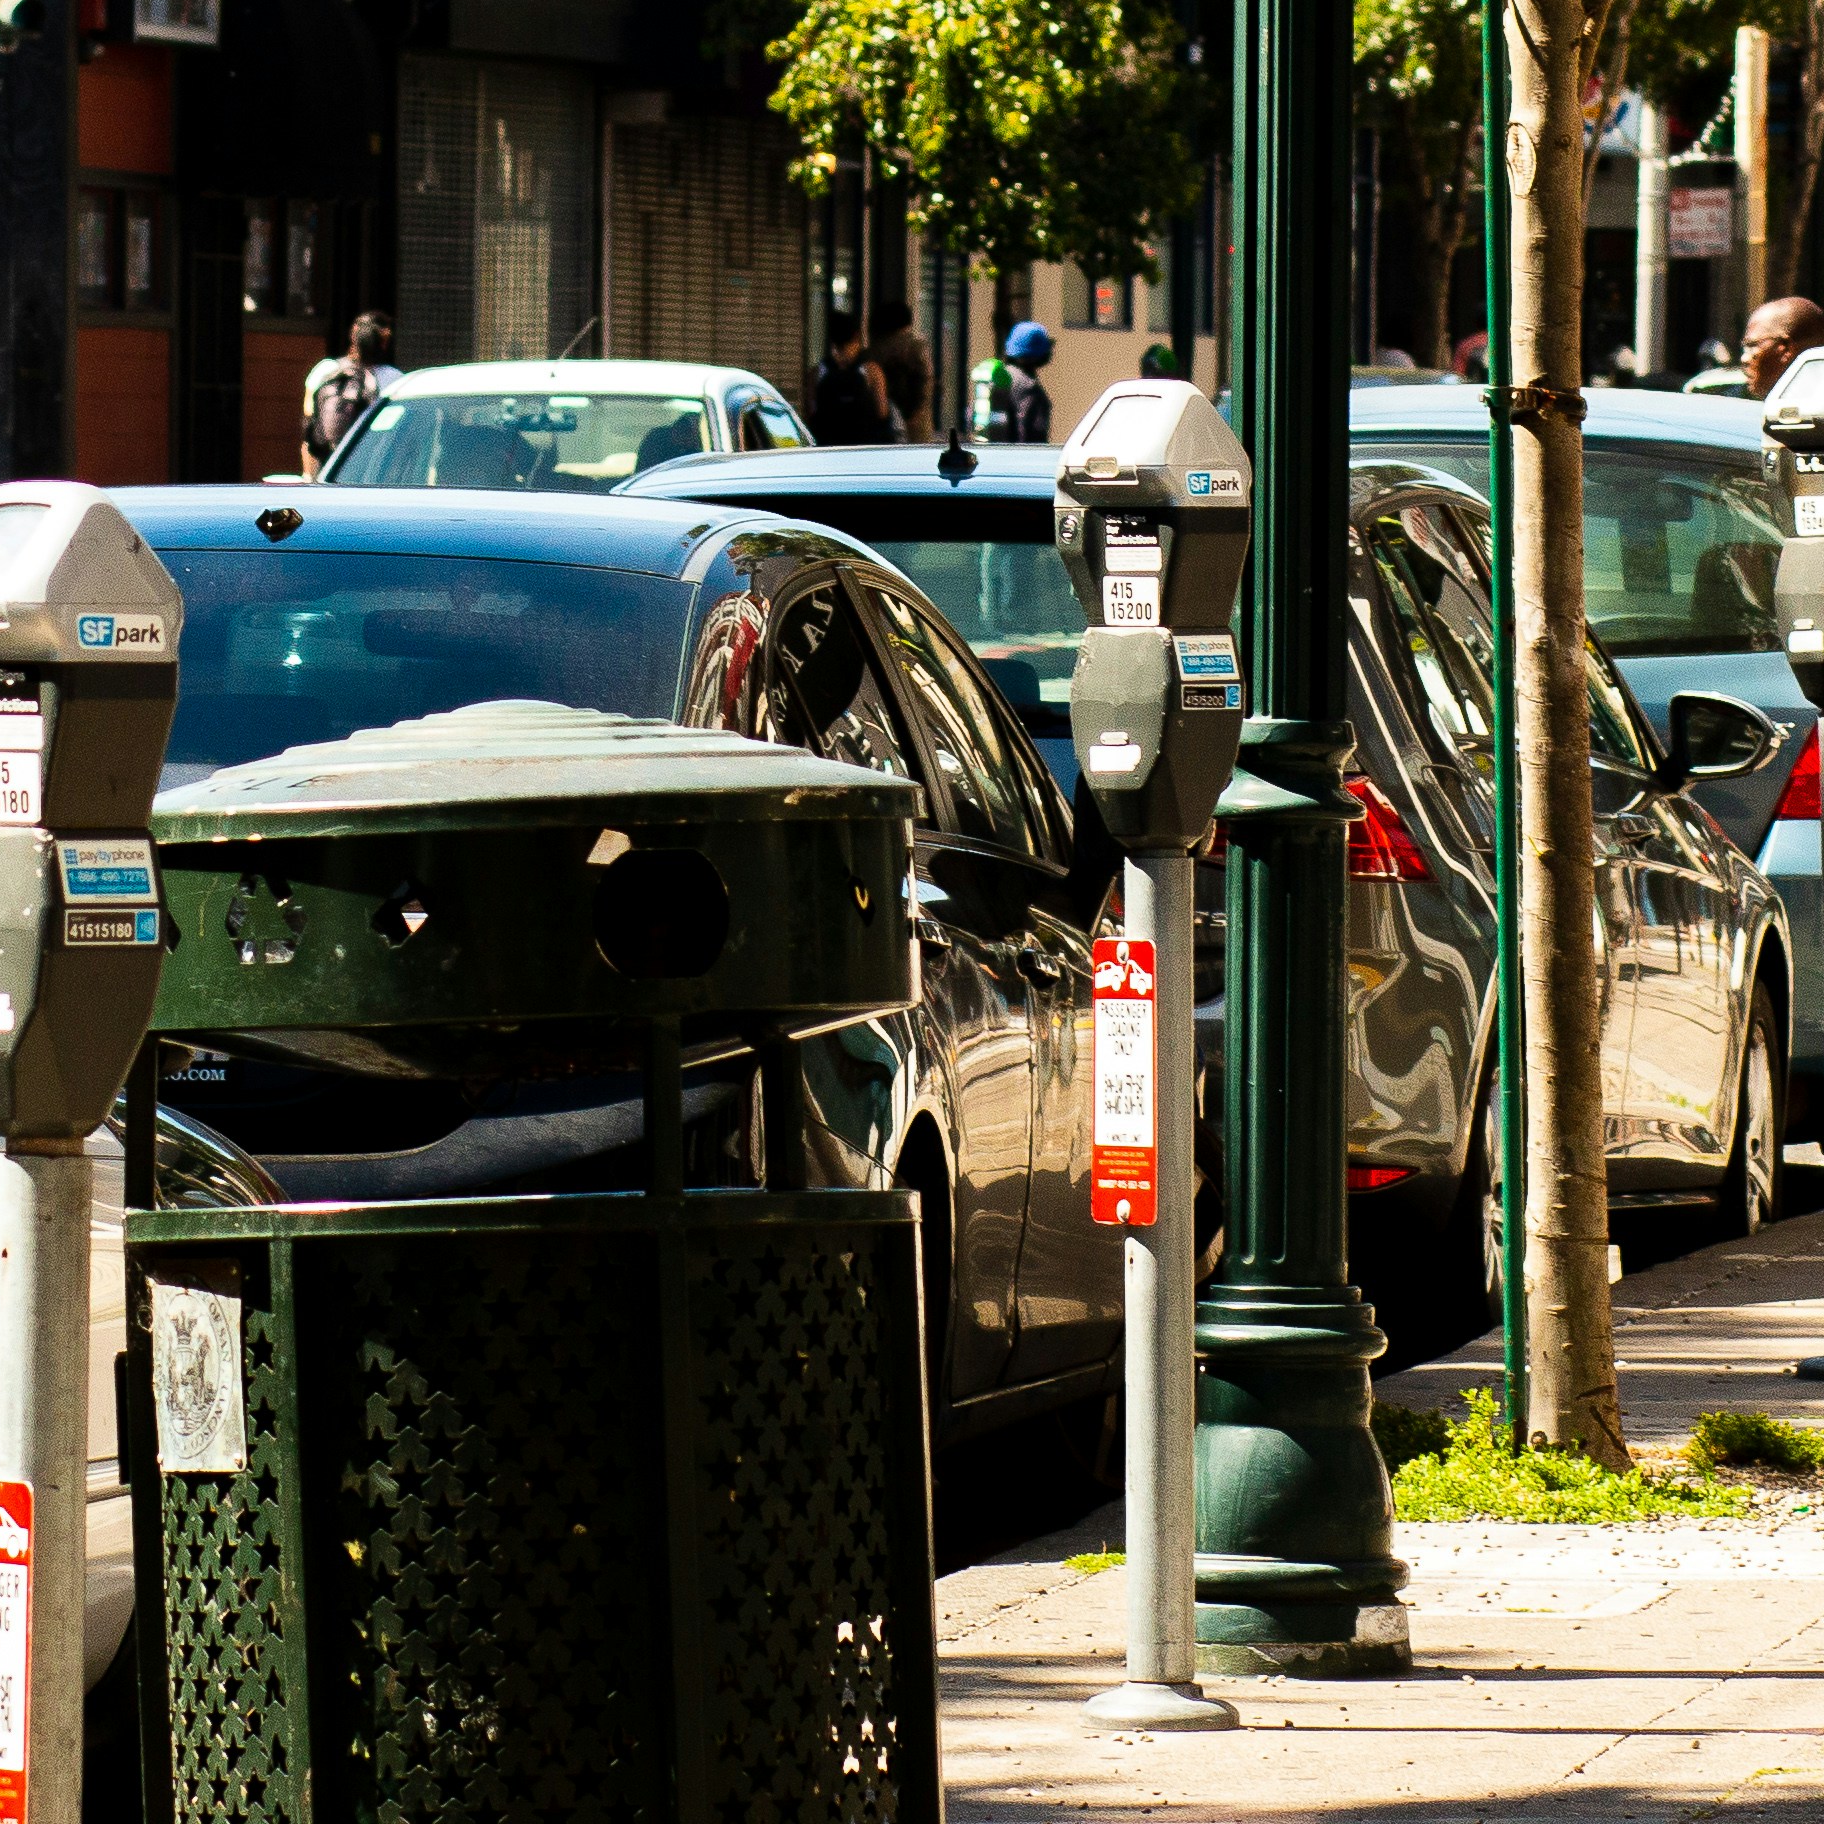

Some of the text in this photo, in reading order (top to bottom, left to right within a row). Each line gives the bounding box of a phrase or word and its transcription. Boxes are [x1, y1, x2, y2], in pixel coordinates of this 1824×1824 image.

[1111, 582, 1133, 599] 415
[1111, 602, 1152, 621] 15200
[69, 922, 134, 939] 41515180
